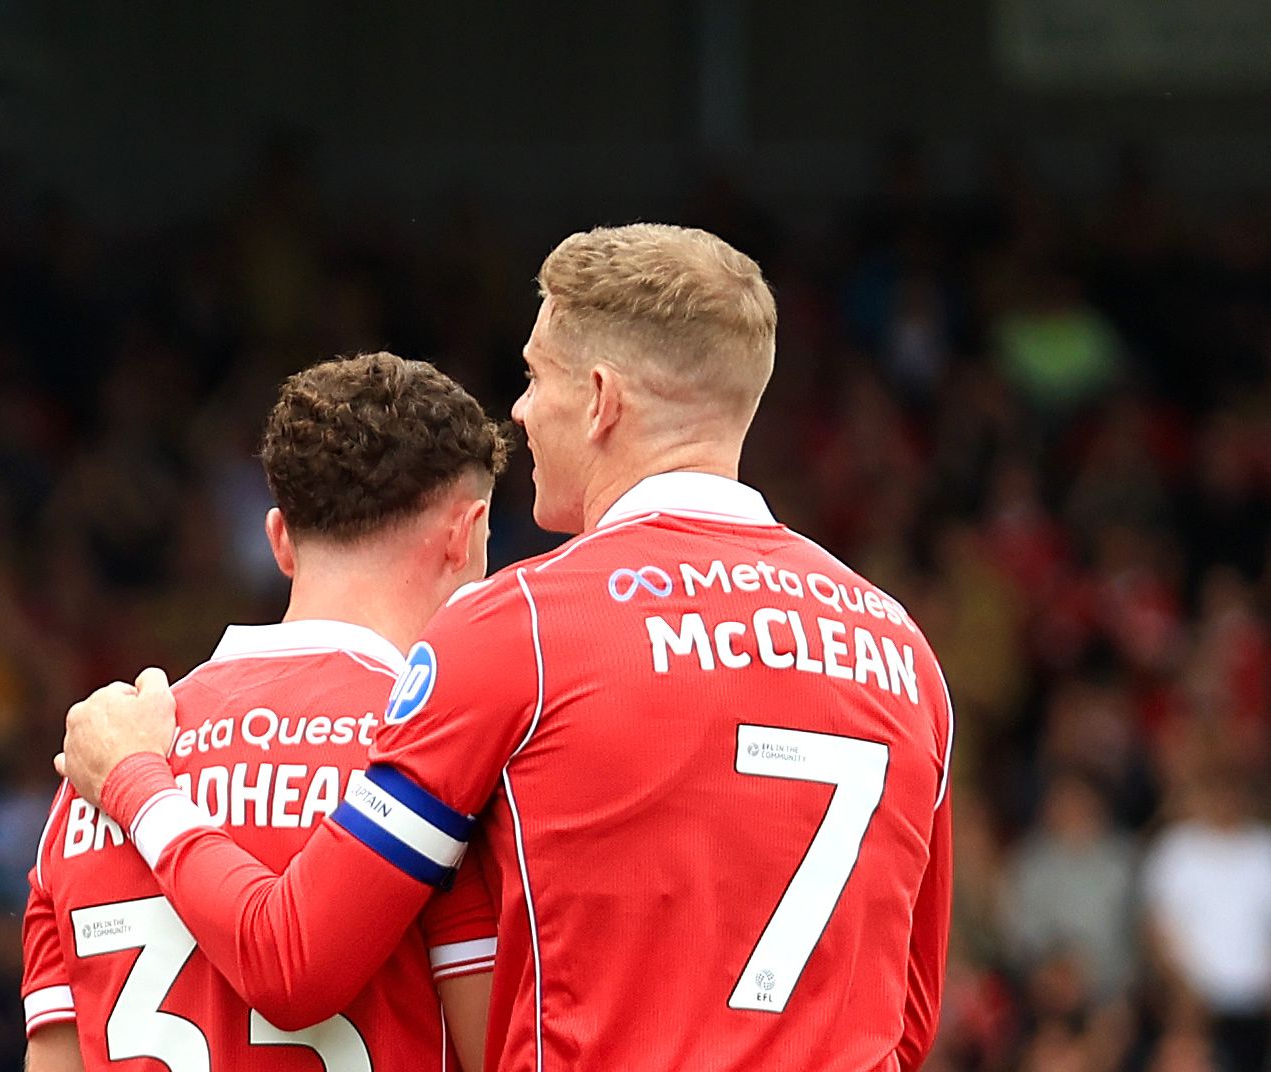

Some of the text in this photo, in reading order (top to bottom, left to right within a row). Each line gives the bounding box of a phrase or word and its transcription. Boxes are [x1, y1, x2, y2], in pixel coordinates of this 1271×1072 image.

[679, 559, 916, 634] Meta Quest
[644, 606, 919, 705] McCLEAN
[167, 707, 379, 758] eta Quest
[62, 763, 369, 859] BRDHEA
[354, 784, 393, 818] PTAIN
[726, 722, 890, 1014] 7
[756, 991, 773, 1003] EFL
